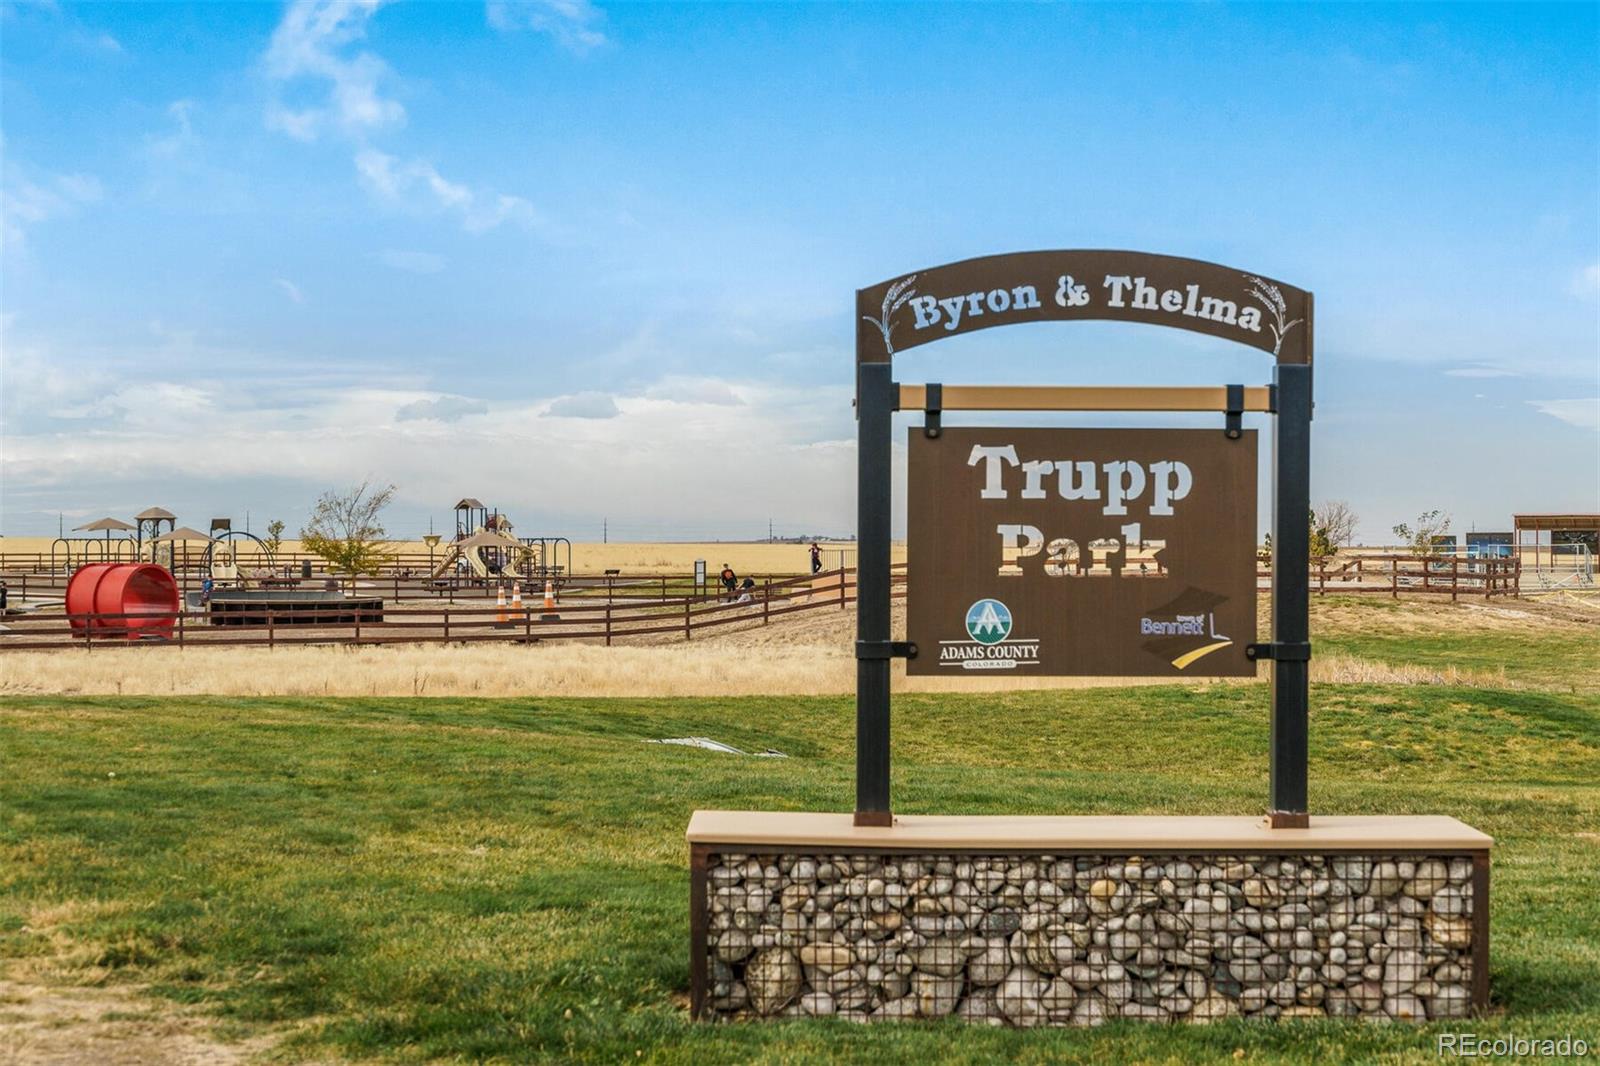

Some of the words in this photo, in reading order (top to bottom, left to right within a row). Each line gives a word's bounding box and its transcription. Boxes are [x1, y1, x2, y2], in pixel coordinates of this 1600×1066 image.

[909, 281, 1040, 331] Byron
[1055, 275, 1089, 306] &
[1103, 275, 1262, 333] Thelma
[967, 444, 1193, 515] Trupp
[997, 522, 1168, 577] Park
[940, 646, 985, 659] ADAMS
[986, 645, 1039, 658] COUNTY
[1141, 618, 1204, 635] Bennett
